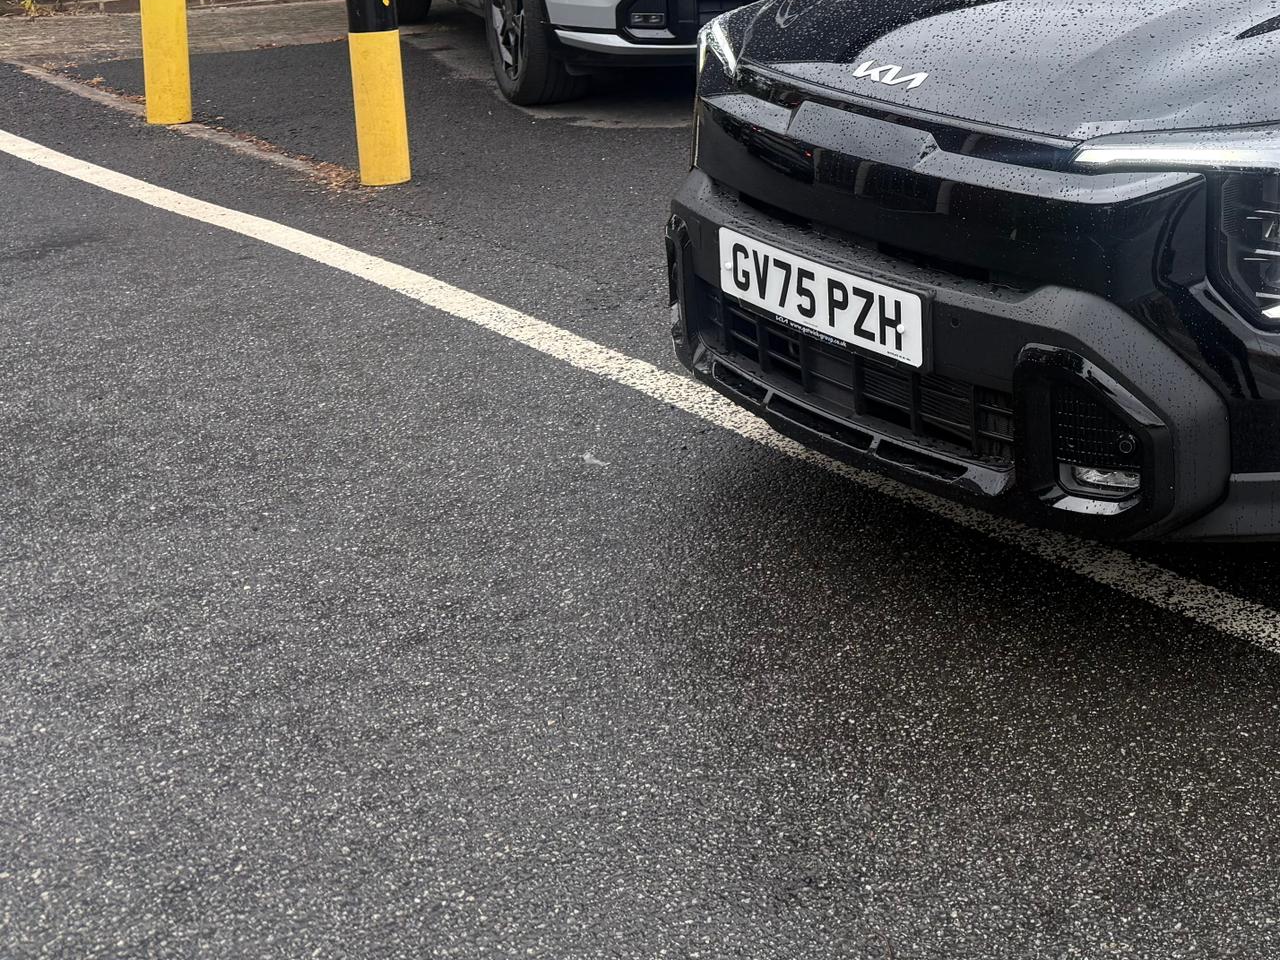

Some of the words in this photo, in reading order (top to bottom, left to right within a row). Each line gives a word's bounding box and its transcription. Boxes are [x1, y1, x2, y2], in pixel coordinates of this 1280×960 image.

[852, 60, 929, 89] KIA
[732, 243, 816, 319] GV75
[827, 277, 903, 351] PZH
